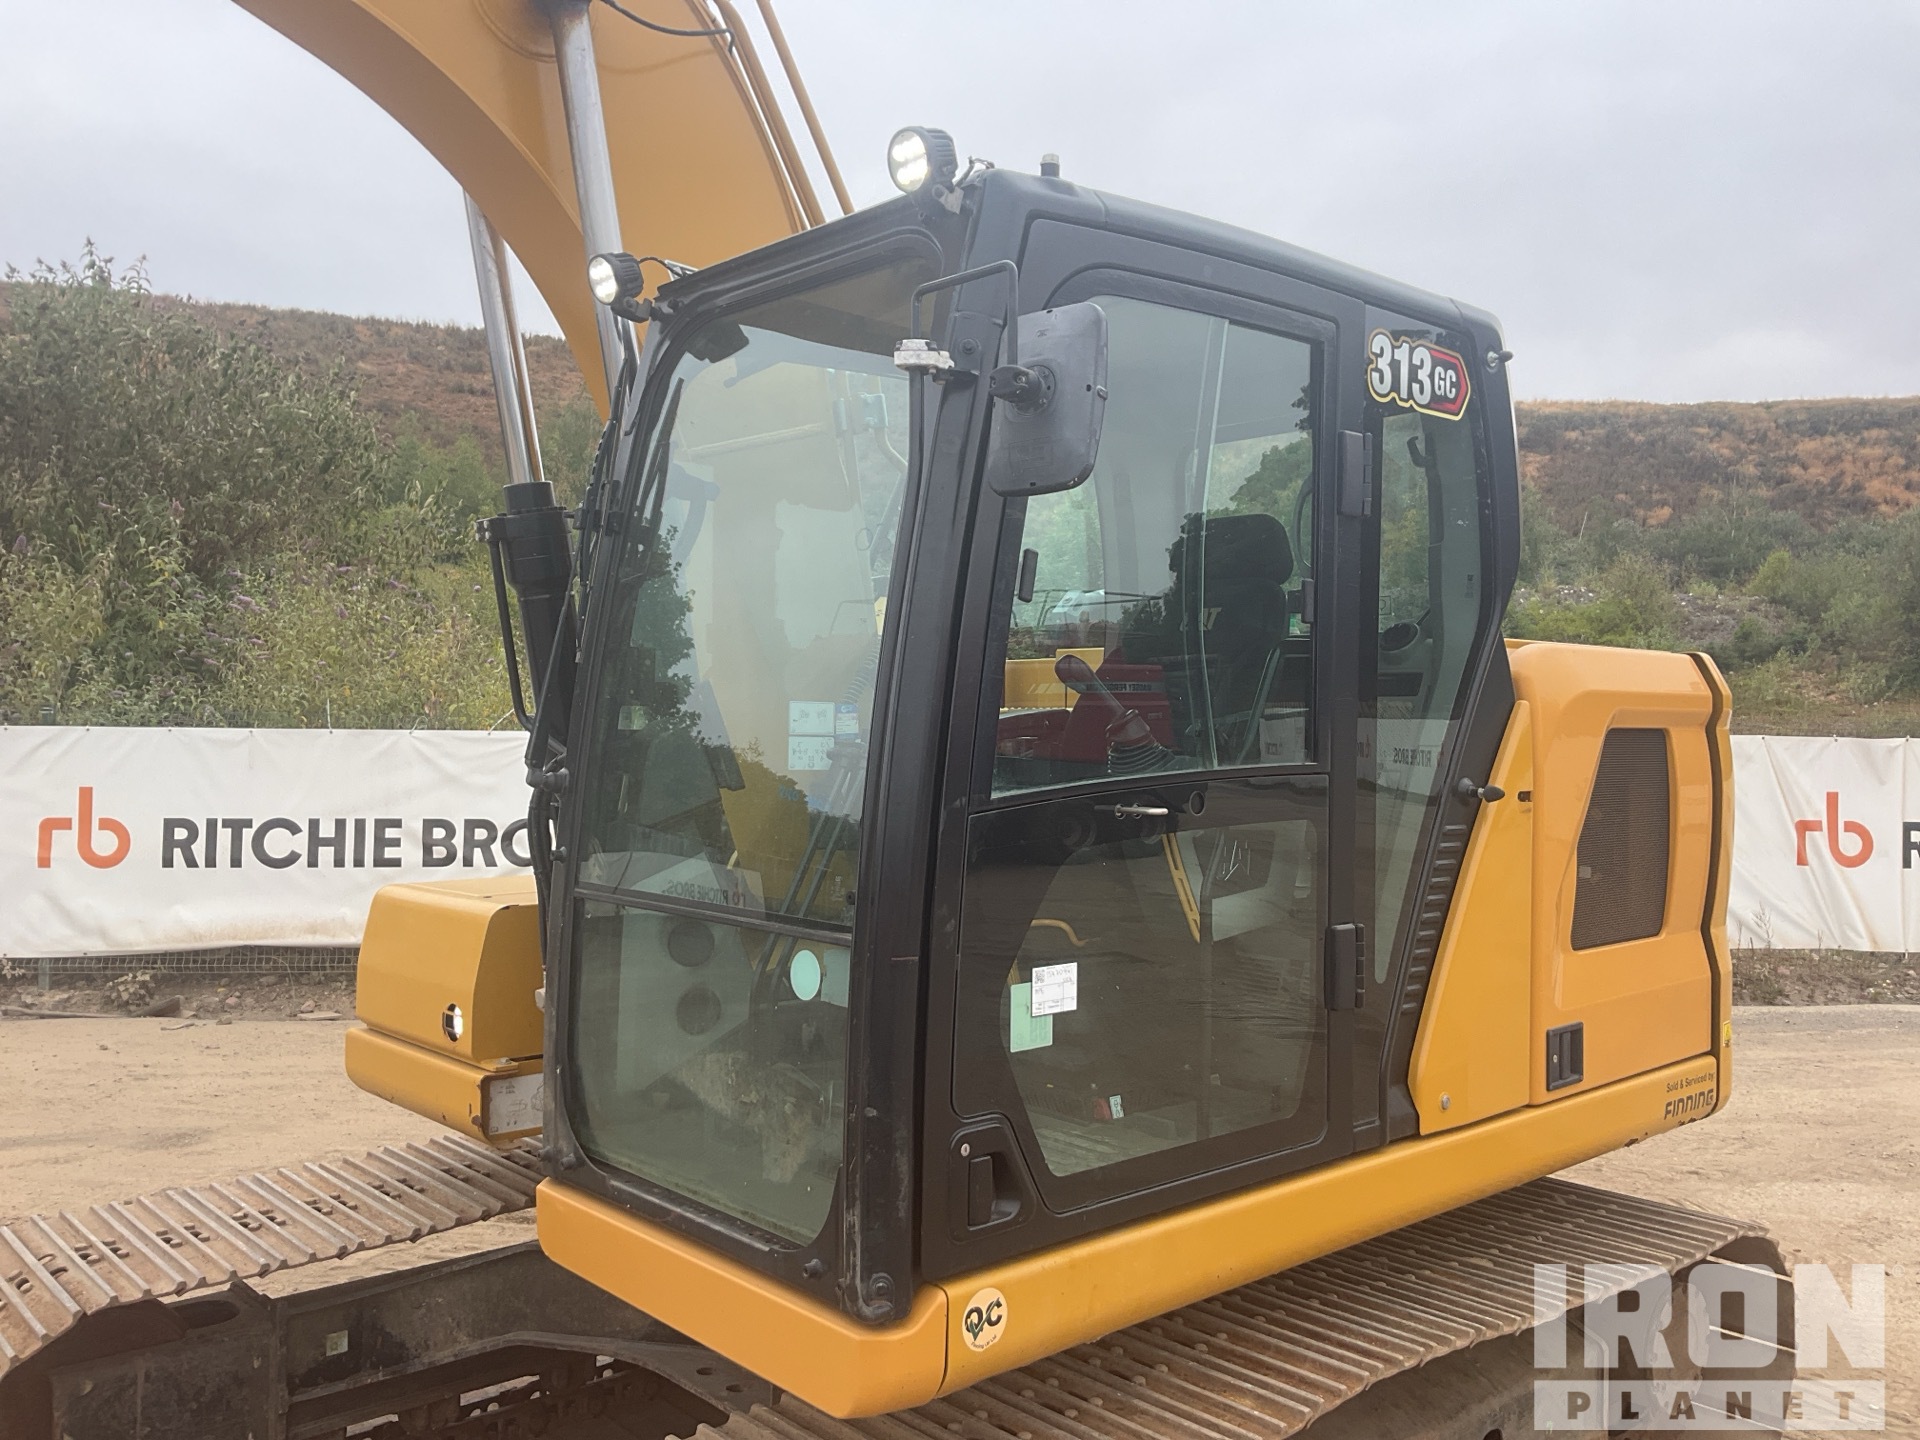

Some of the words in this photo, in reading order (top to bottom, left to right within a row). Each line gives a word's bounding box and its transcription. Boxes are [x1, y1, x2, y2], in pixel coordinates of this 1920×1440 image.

[1371, 334, 1432, 405] 313
[162, 817, 402, 869] RITCHIE
[1666, 1081, 1679, 1093] Sold
[1685, 1074, 1707, 1087] Serviced
[1664, 1088, 1714, 1120] FINNING
[964, 1298, 1003, 1333] QC
